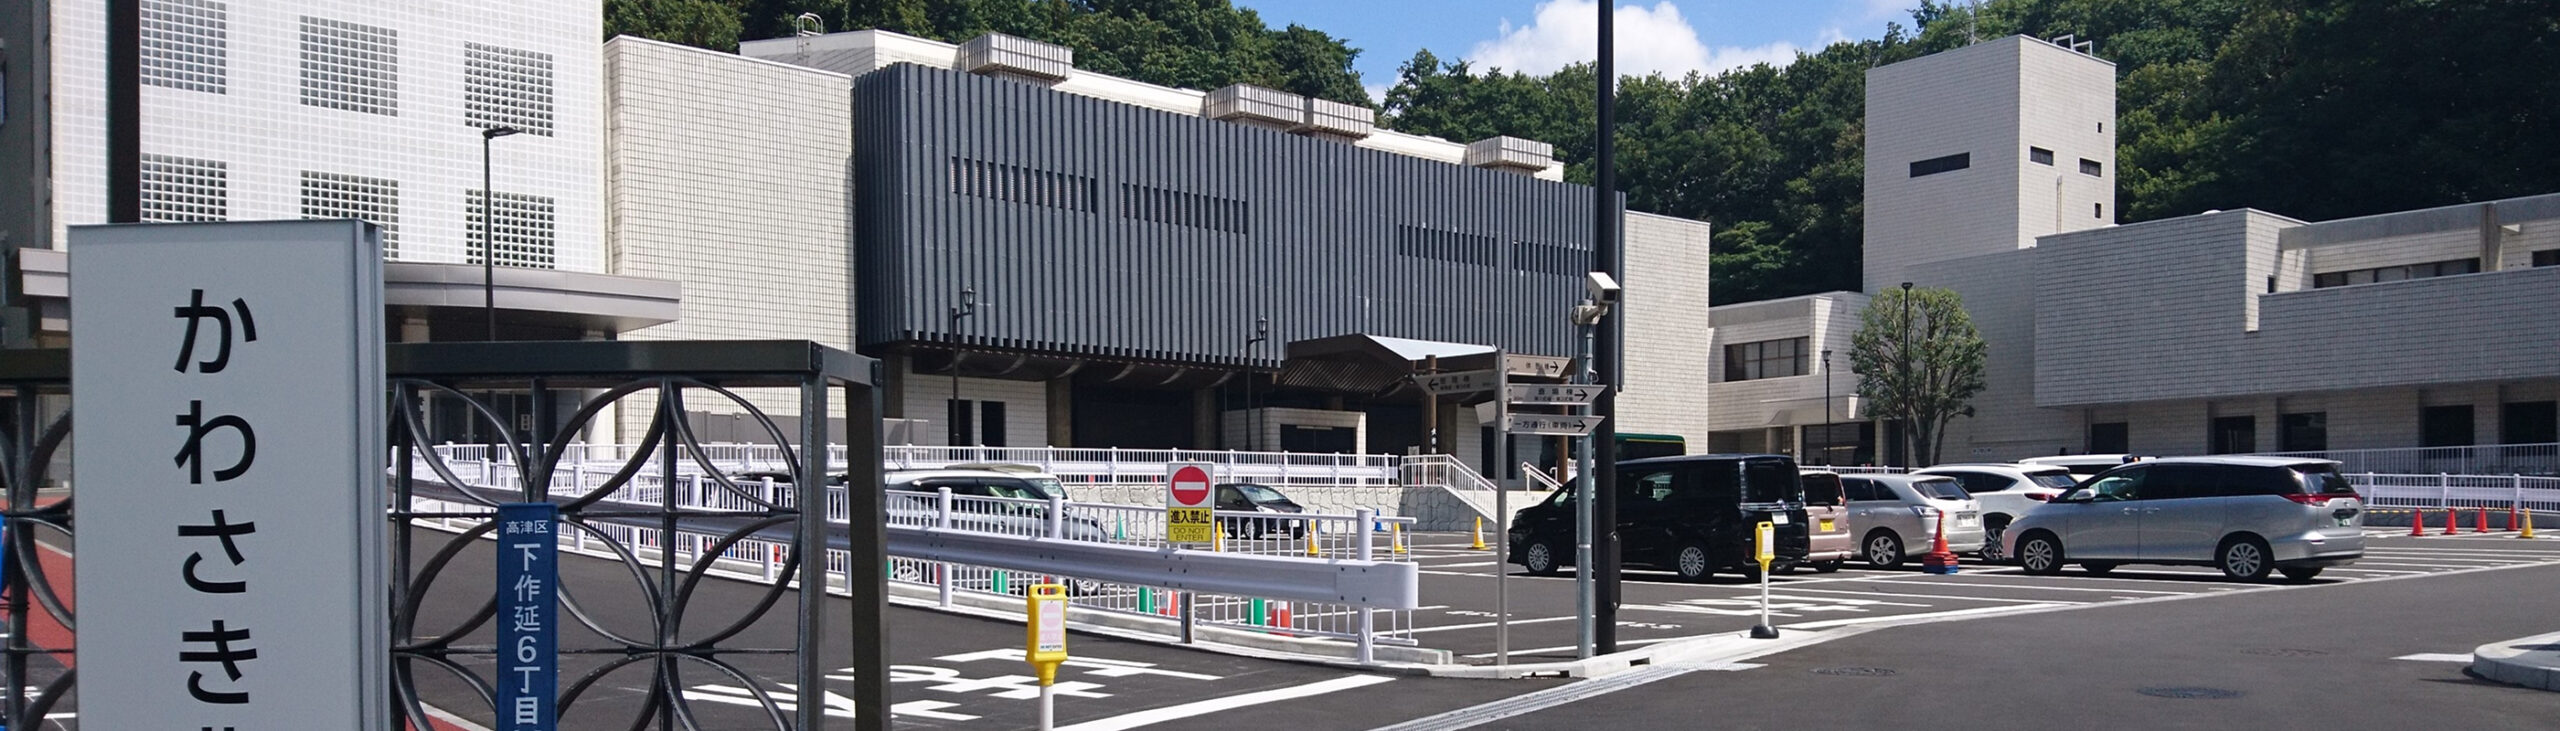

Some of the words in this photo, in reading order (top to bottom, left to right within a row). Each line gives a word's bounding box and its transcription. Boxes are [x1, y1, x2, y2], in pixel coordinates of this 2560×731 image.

[174, 289, 257, 731] かわさき
[506, 520, 548, 534] 高津区
[1170, 510, 1209, 524] 進入禁止
[514, 543, 541, 731] 下作延6丁目
